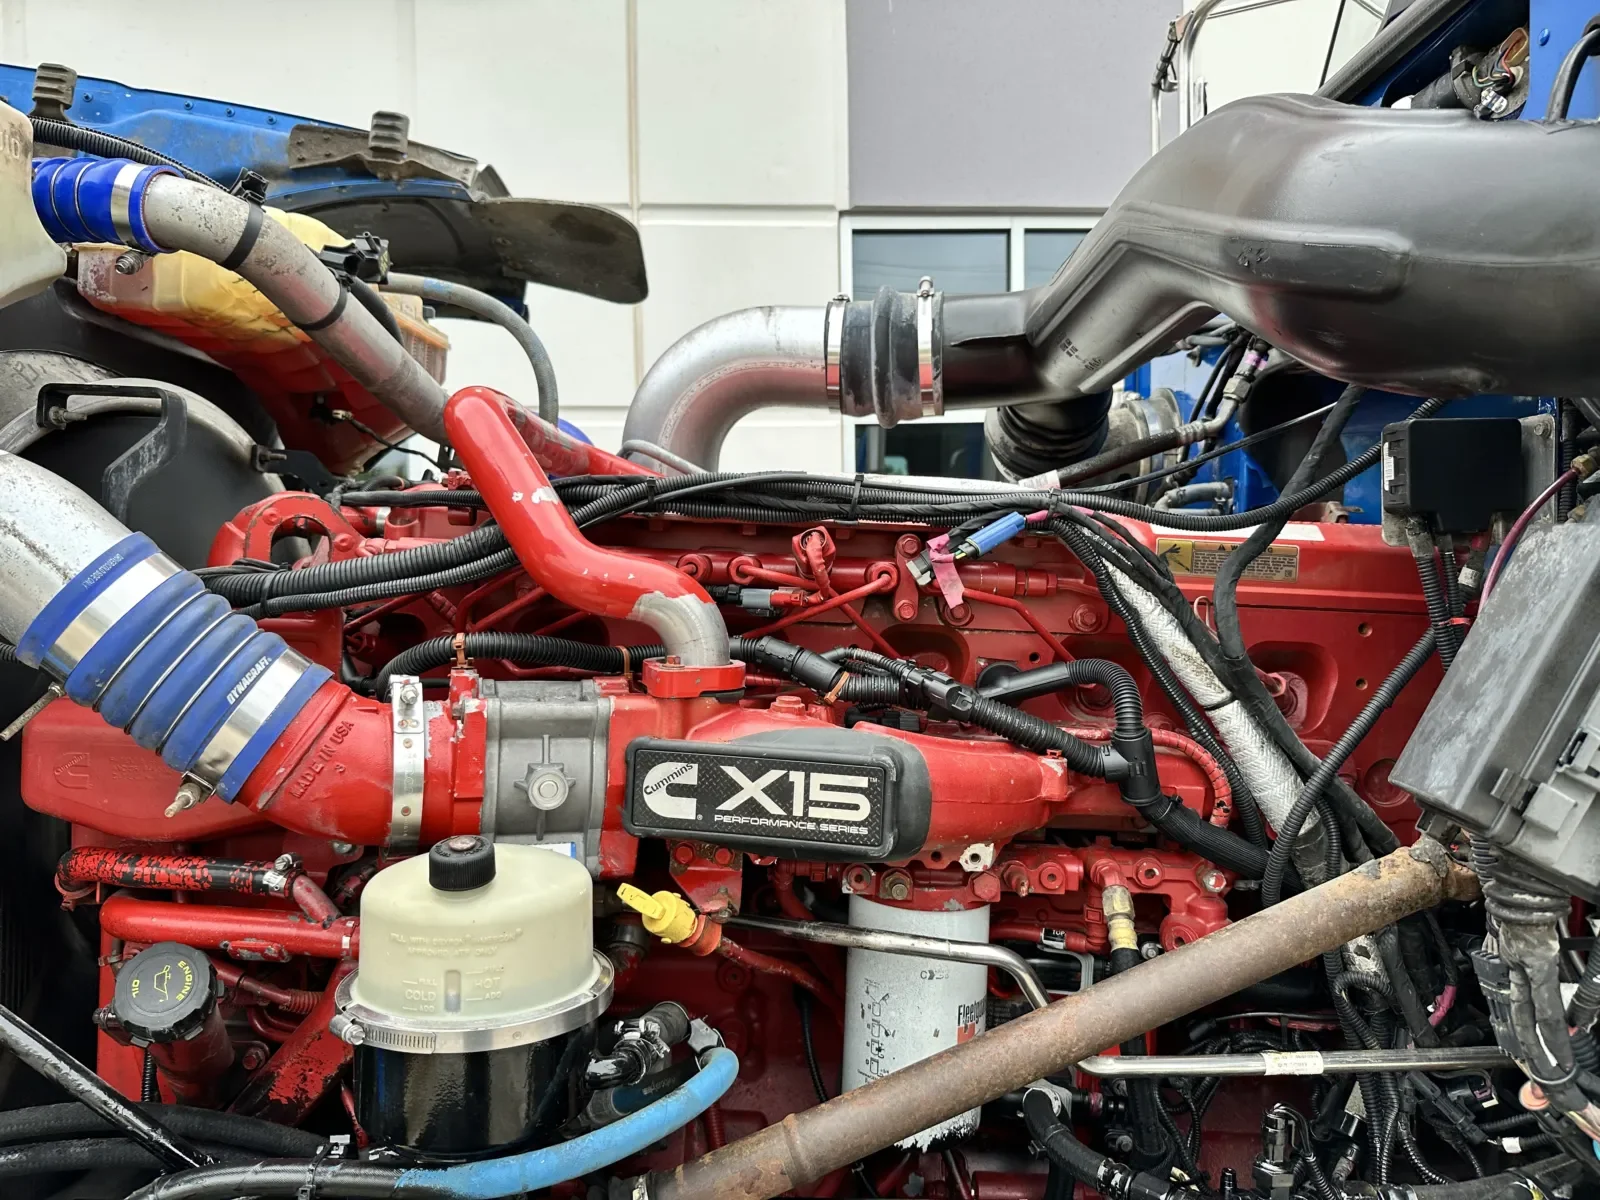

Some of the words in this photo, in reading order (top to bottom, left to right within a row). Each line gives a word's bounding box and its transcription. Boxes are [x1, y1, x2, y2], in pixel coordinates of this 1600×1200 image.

[318, 744, 338, 762] IN
[329, 720, 355, 744] USA
[643, 763, 694, 796] Cummins
[715, 765, 871, 822] X15
[714, 814, 816, 830] PERFORMANCE
[819, 823, 869, 835] SERIES
[131, 979, 140, 998] OIL
[176, 960, 193, 1001] ENGINE
[475, 977, 502, 989] HOT
[405, 989, 437, 1001] COLD
